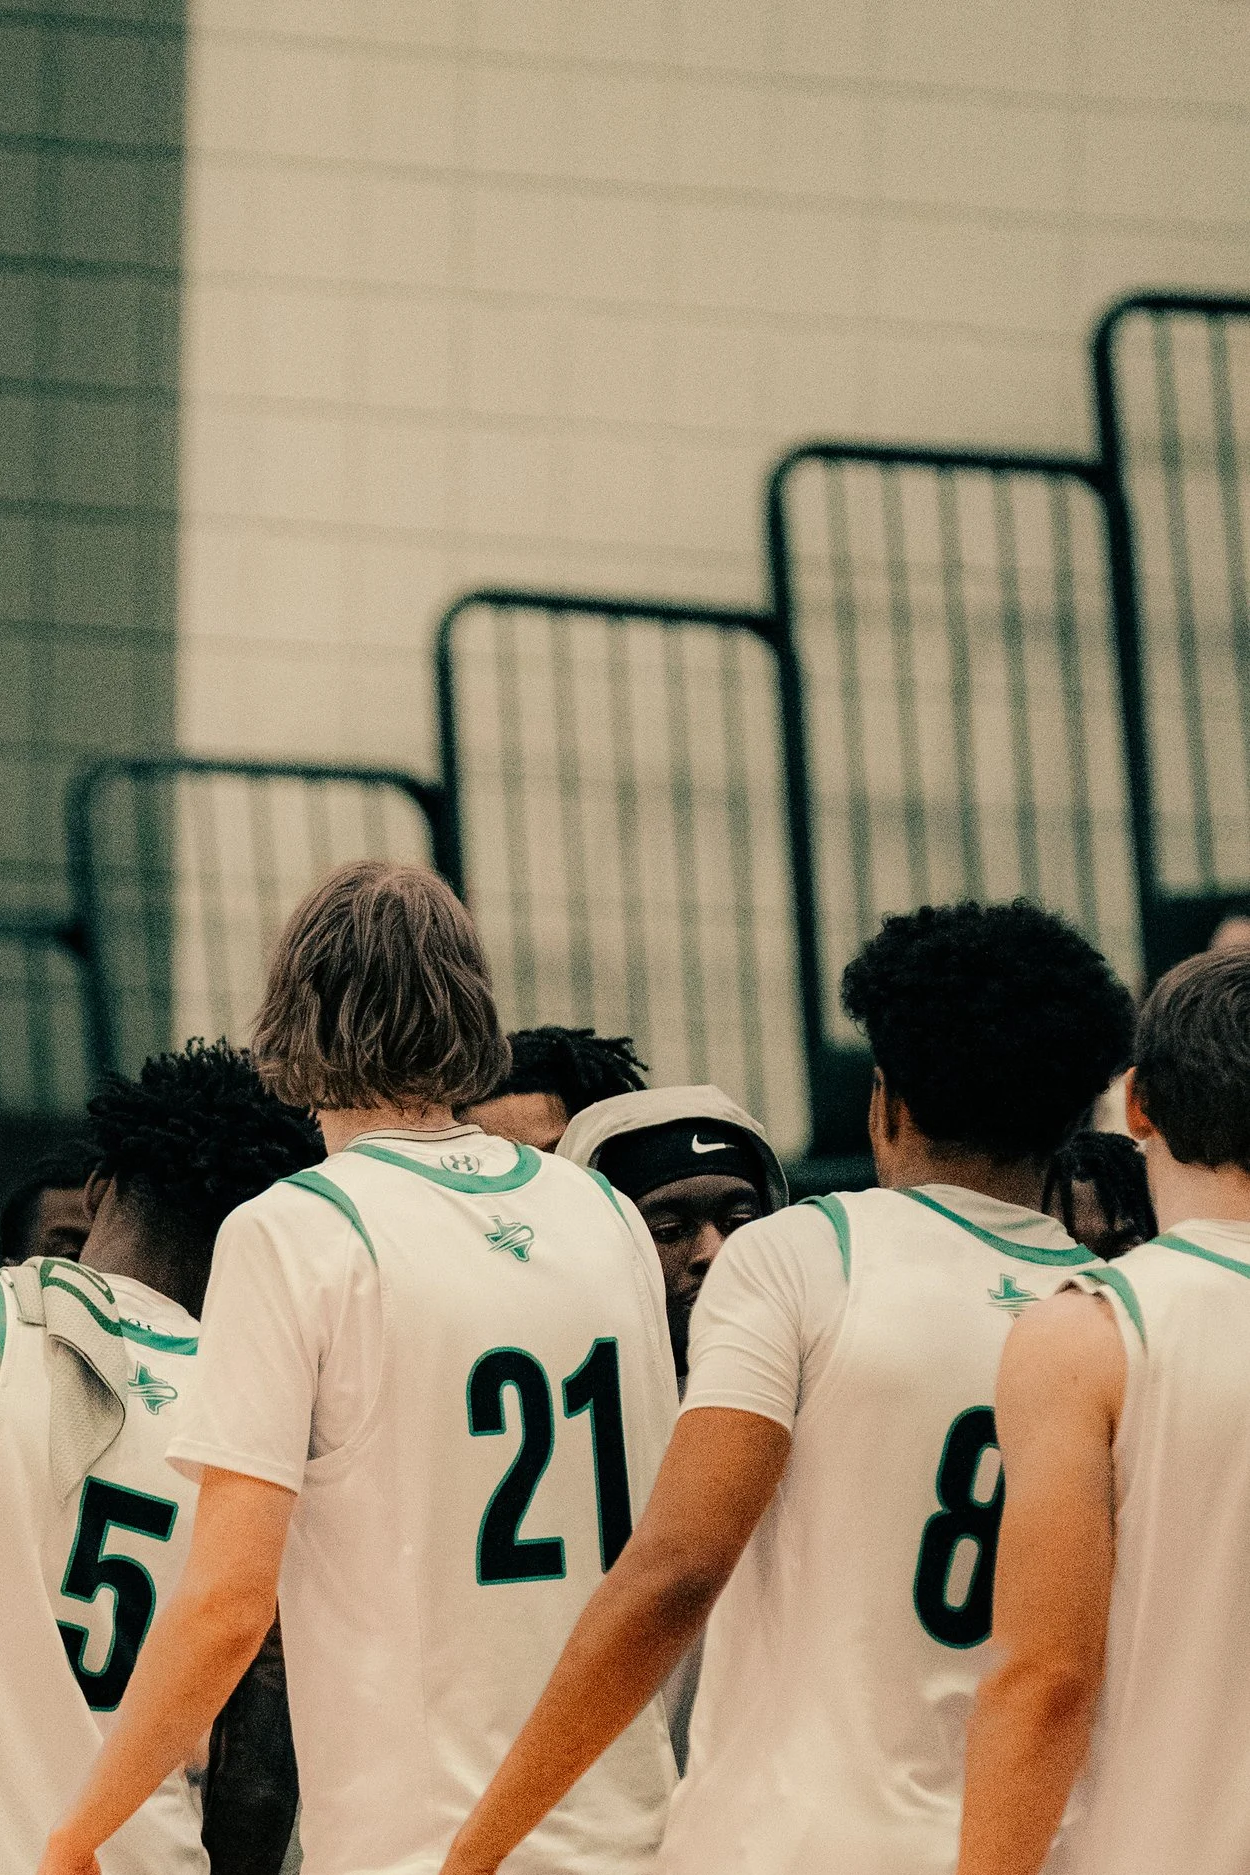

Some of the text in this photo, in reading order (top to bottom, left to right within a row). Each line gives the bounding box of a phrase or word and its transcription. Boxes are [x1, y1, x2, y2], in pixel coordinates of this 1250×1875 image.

[466, 1337, 633, 1585] 21
[913, 1405, 1006, 1649] 8
[54, 1476, 179, 1712] 5
